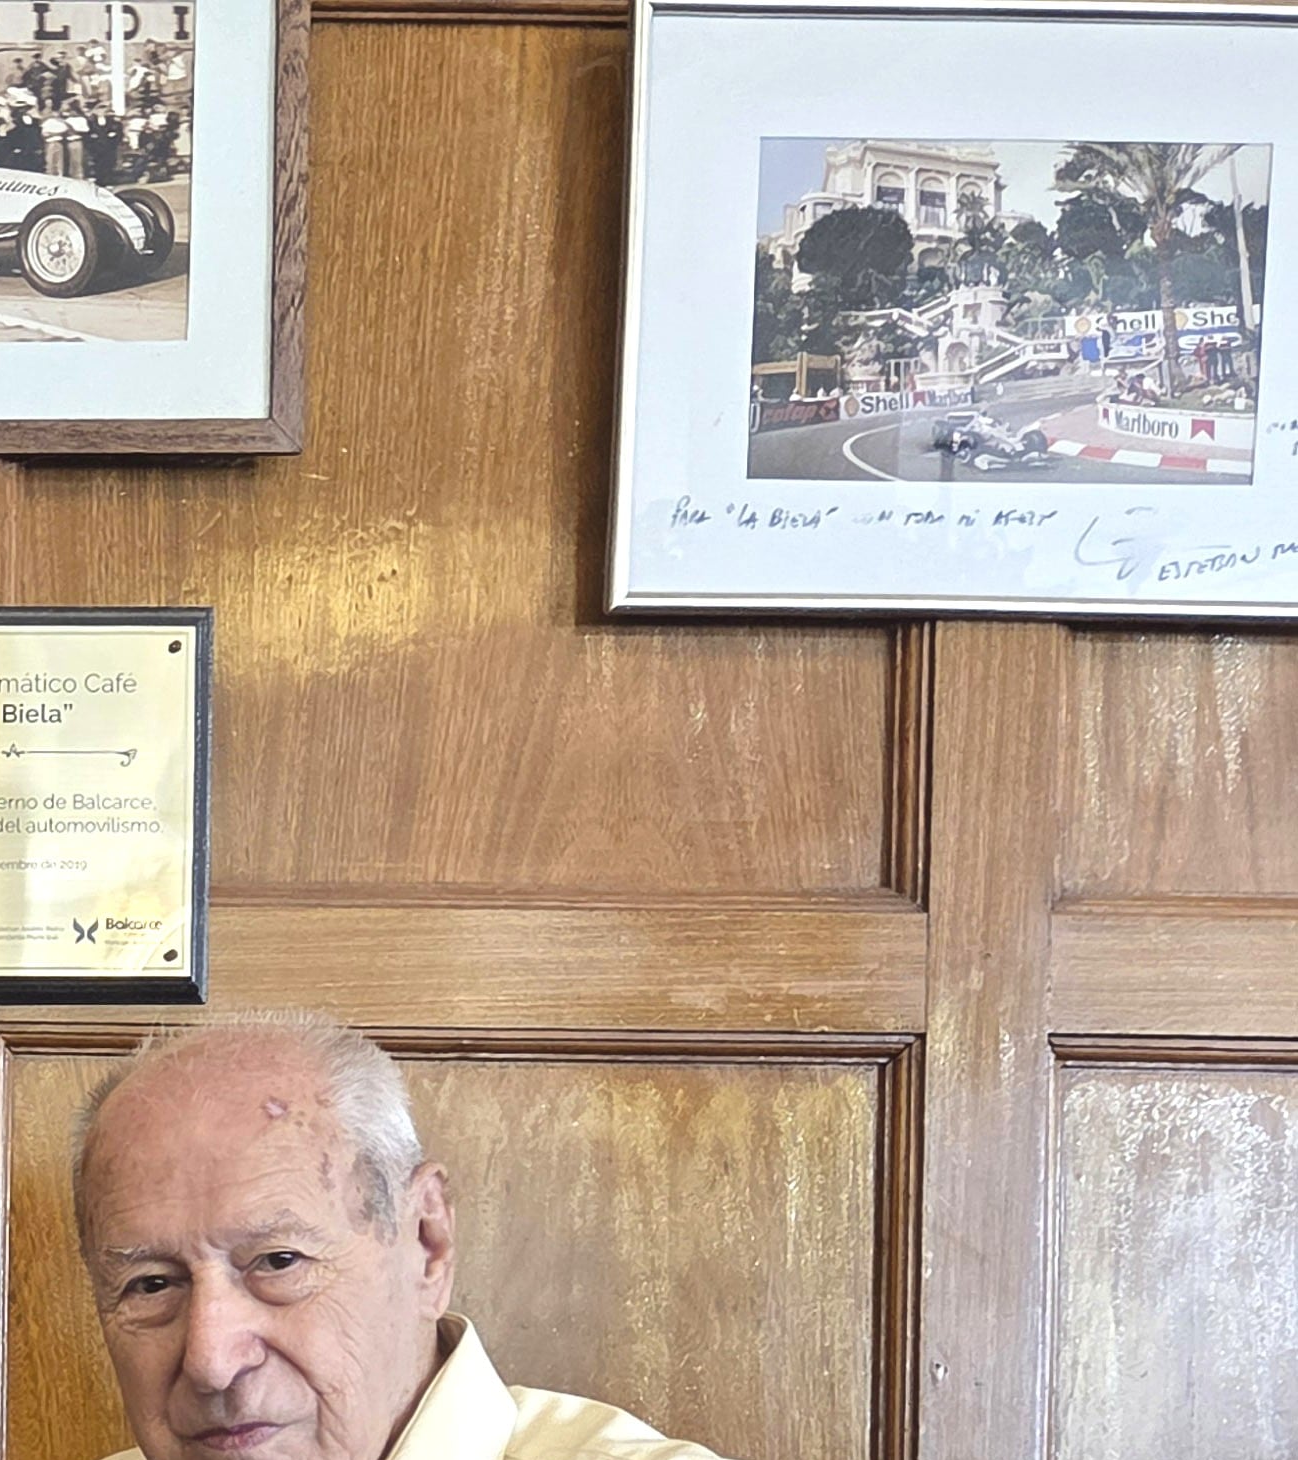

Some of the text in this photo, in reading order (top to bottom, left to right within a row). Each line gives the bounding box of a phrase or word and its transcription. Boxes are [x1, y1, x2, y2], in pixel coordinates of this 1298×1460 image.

[860, 392, 910, 415] Shell
[1114, 409, 1180, 439] Marlboro
[84, 671, 138, 693] Café
[2, 703, 74, 723] Biela"
[43, 793, 67, 810] de
[59, 860, 88, 871] 2019
[105, 917, 163, 931] Balcarce
